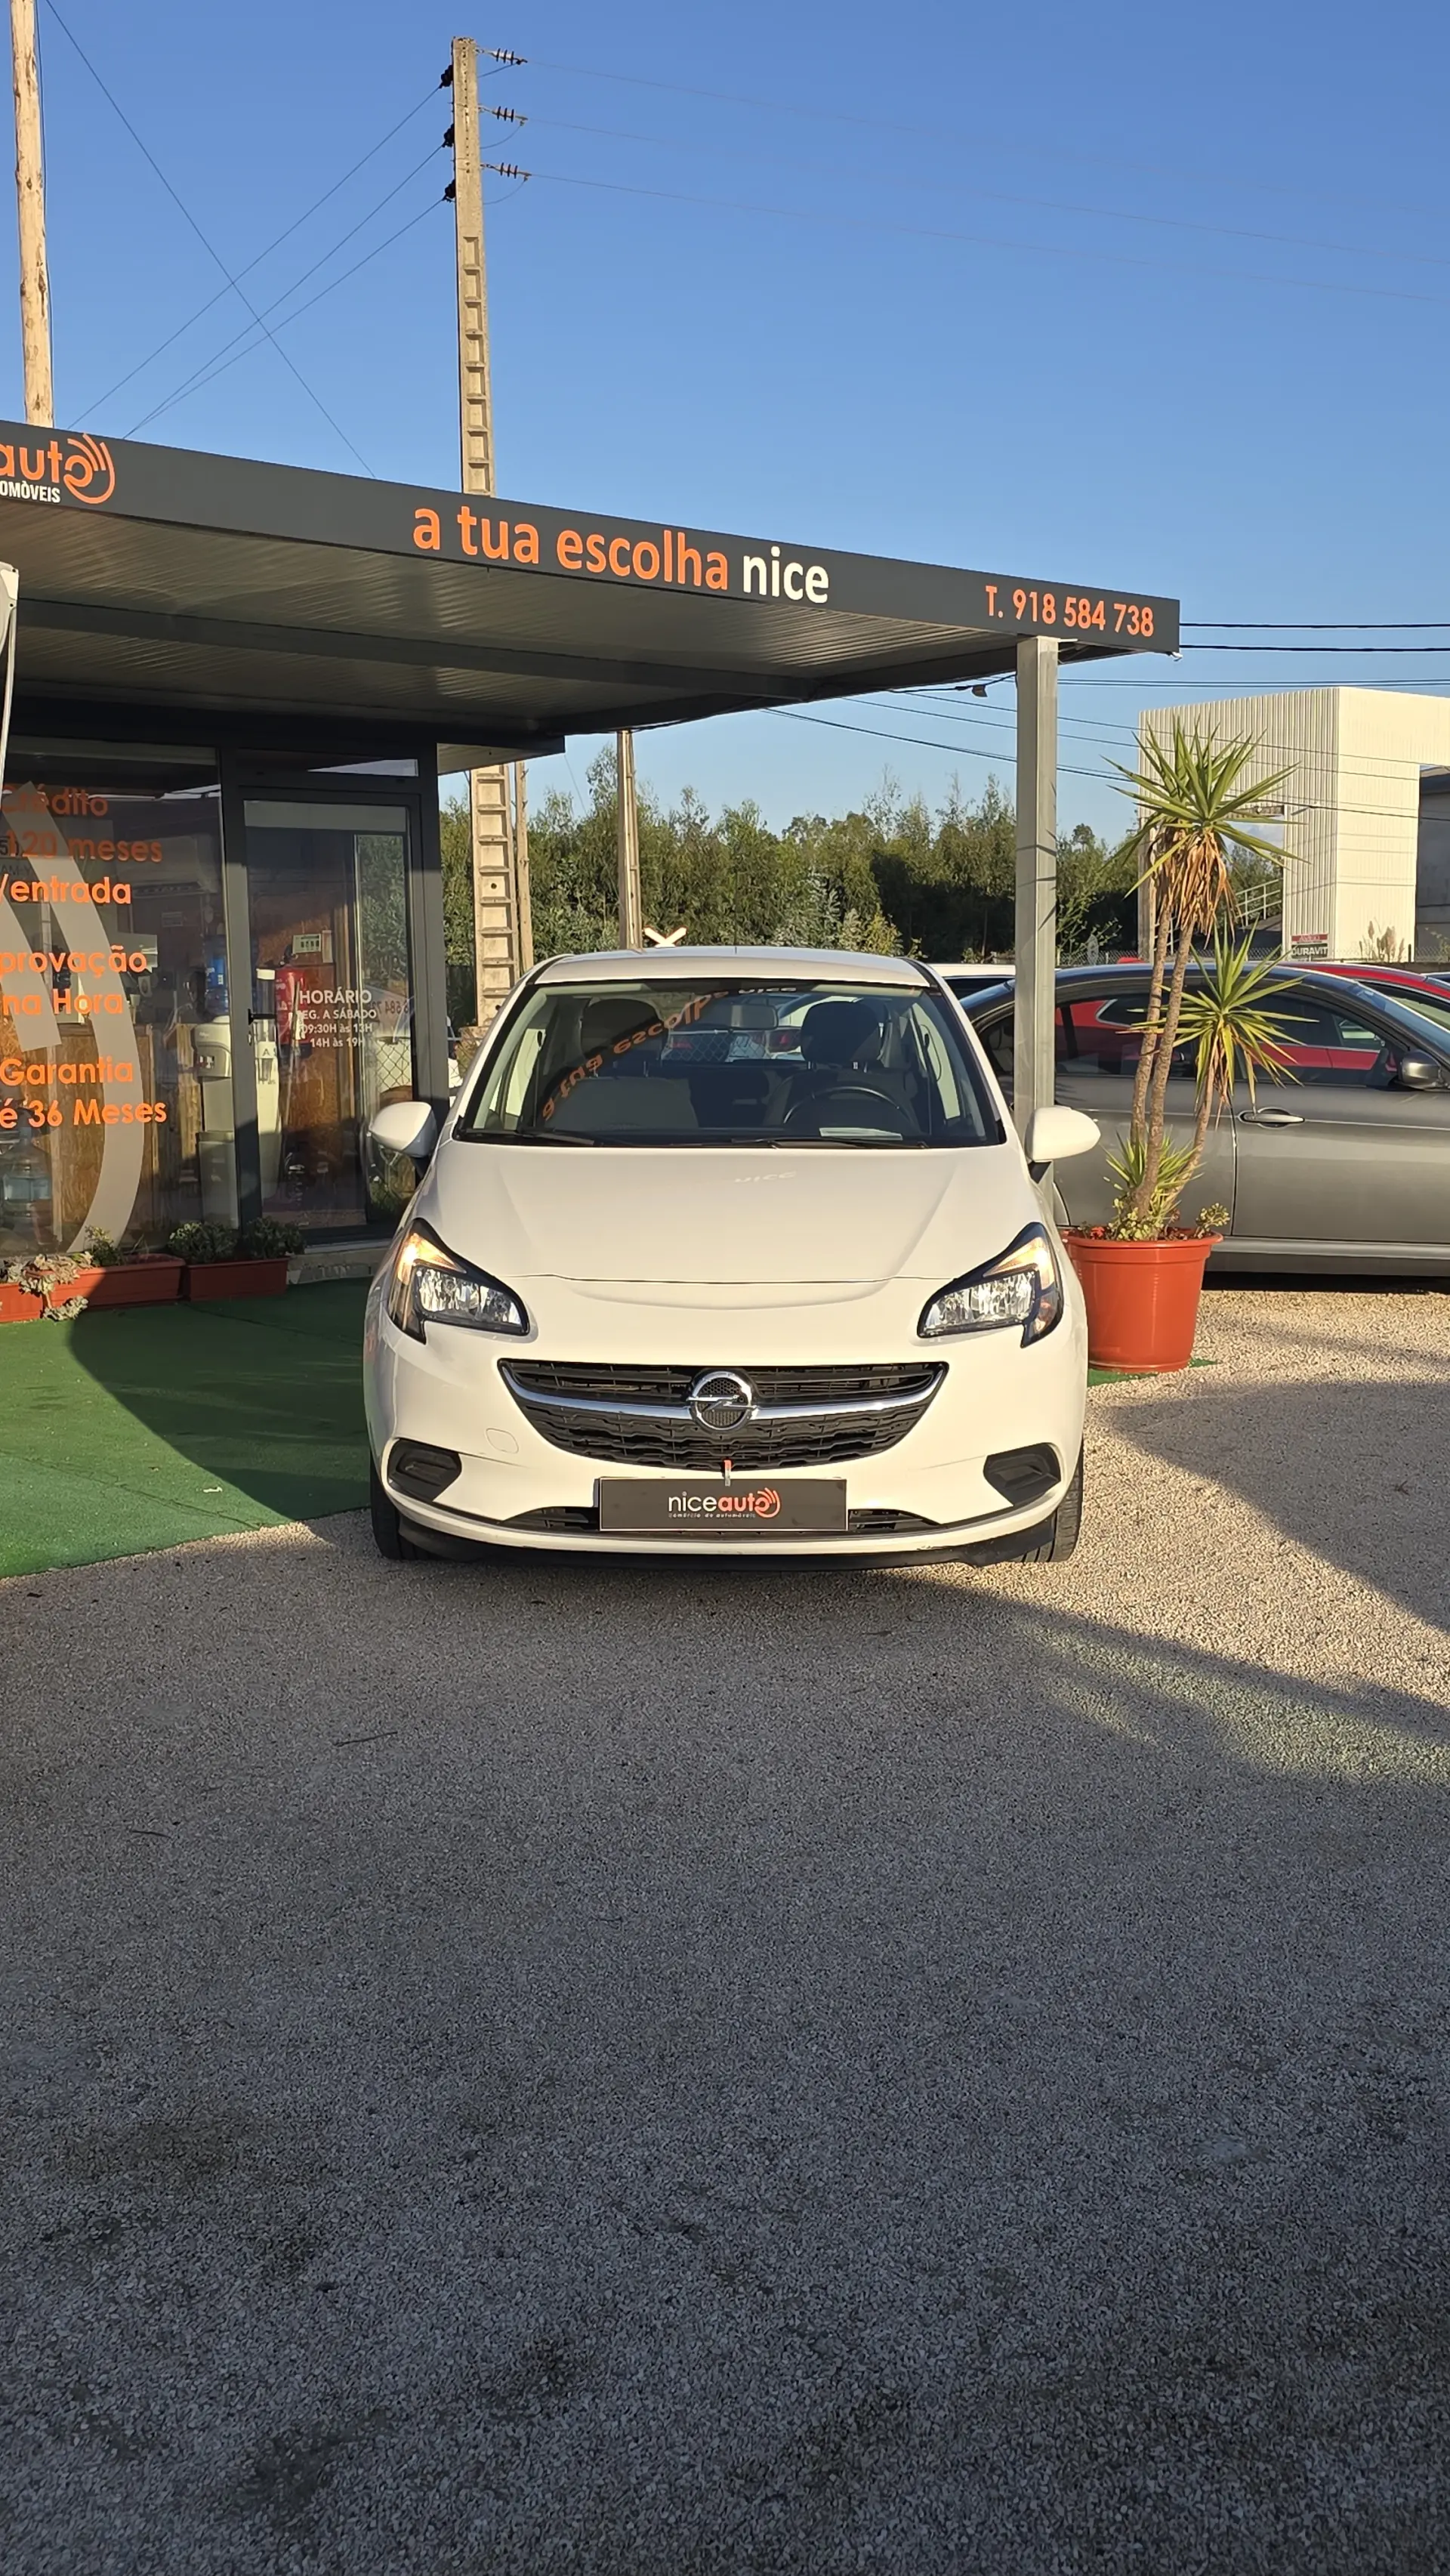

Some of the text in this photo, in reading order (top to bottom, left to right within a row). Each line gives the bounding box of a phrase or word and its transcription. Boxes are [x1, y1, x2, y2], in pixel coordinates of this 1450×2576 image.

[413, 506, 829, 604] a tua escolha nice
[986, 585, 1154, 638] T. 918 584 738
[2, 783, 109, 817] Crédito
[68, 837, 163, 863] meses
[0, 944, 147, 981] provação
[2, 988, 123, 1015] na Hora
[299, 986, 372, 1004] HORÁRIO
[322, 1009, 331, 1020] A
[333, 1006, 377, 1020] SÁBADO
[310, 1037, 330, 1048] 14H
[0, 1055, 133, 1086] Garantia
[28, 1100, 63, 1127] 36
[73, 1098, 167, 1126] Meses
